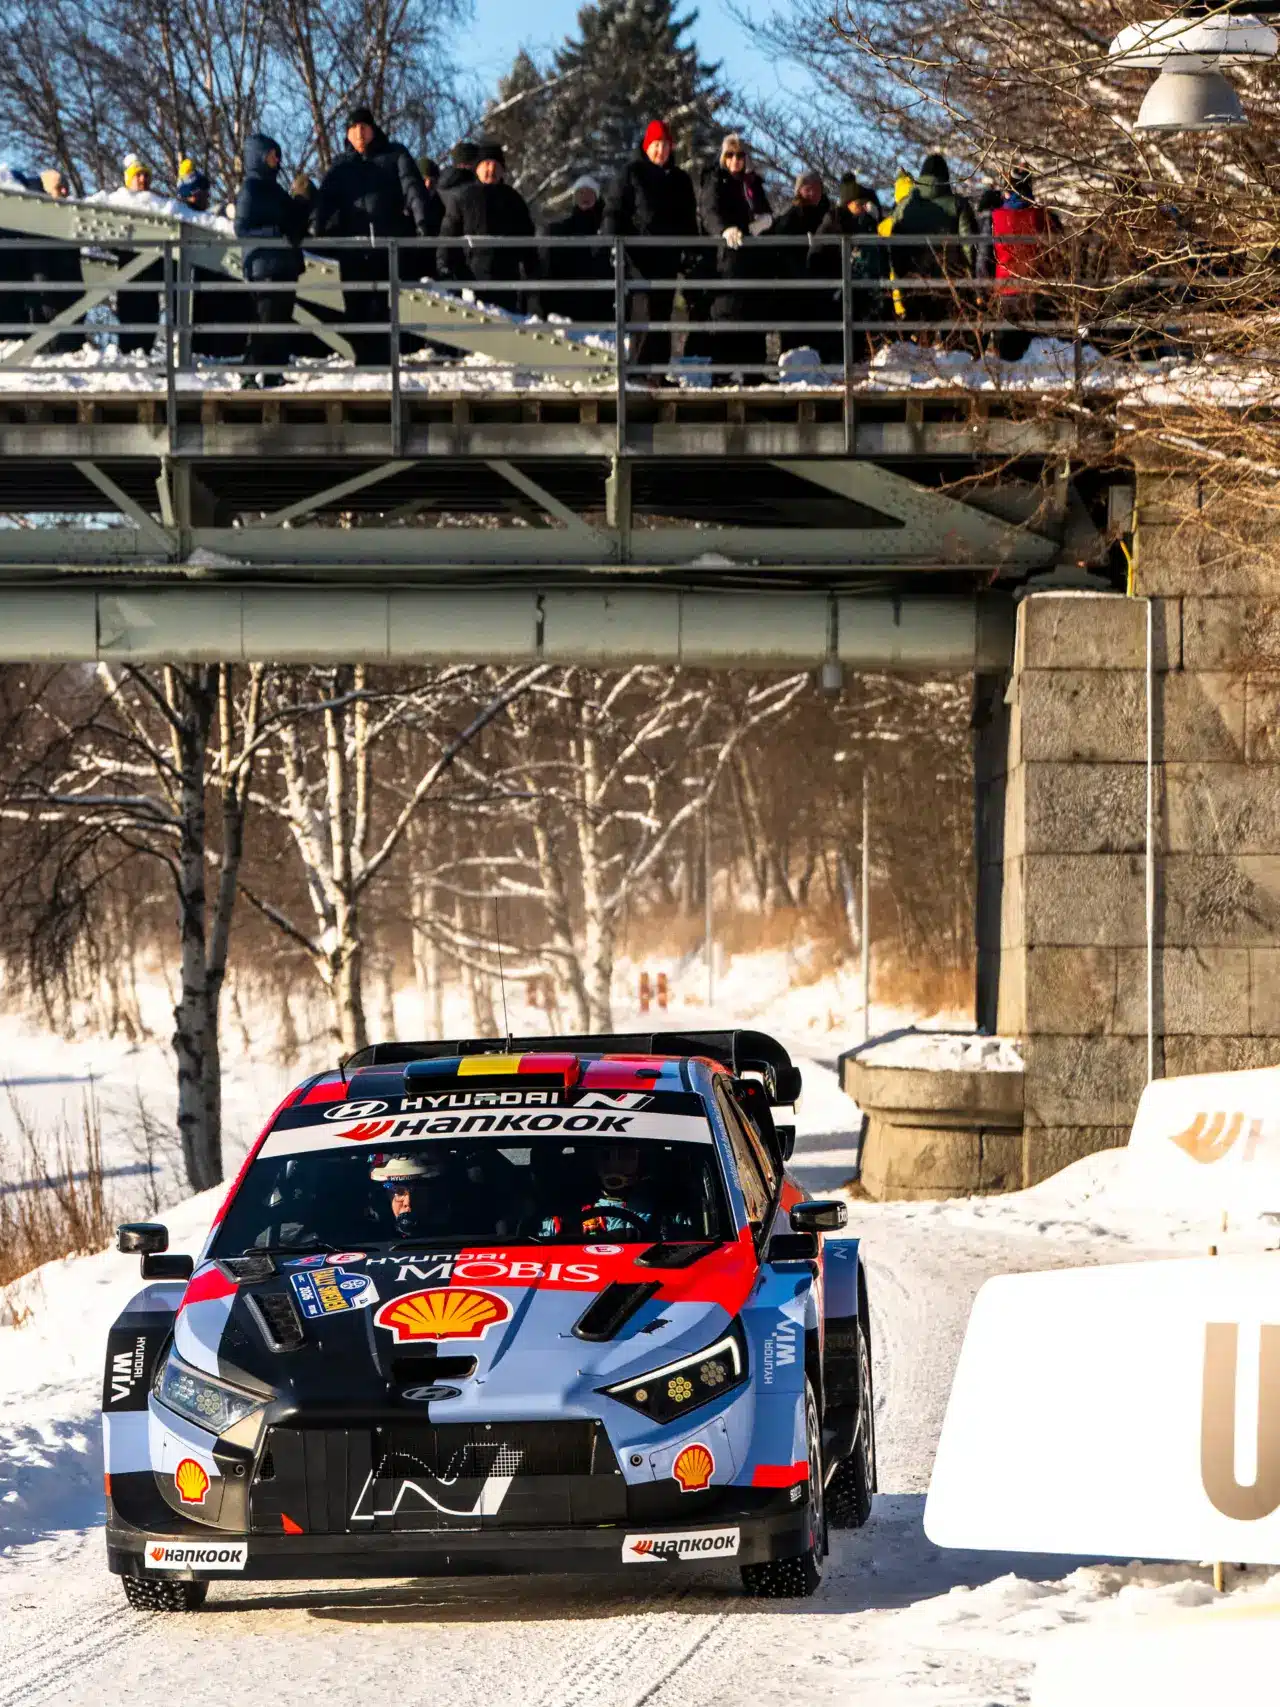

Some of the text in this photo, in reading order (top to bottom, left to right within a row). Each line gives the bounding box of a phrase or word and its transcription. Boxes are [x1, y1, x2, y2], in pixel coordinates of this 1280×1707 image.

[400, 1091, 558, 1112] HYUNDAI
[366, 1253, 507, 1266] HYUNDAI
[394, 1261, 600, 1283] MOBIS
[133, 1336, 146, 1378] HYUNDAI
[764, 1339, 774, 1385] HYUNDAI
